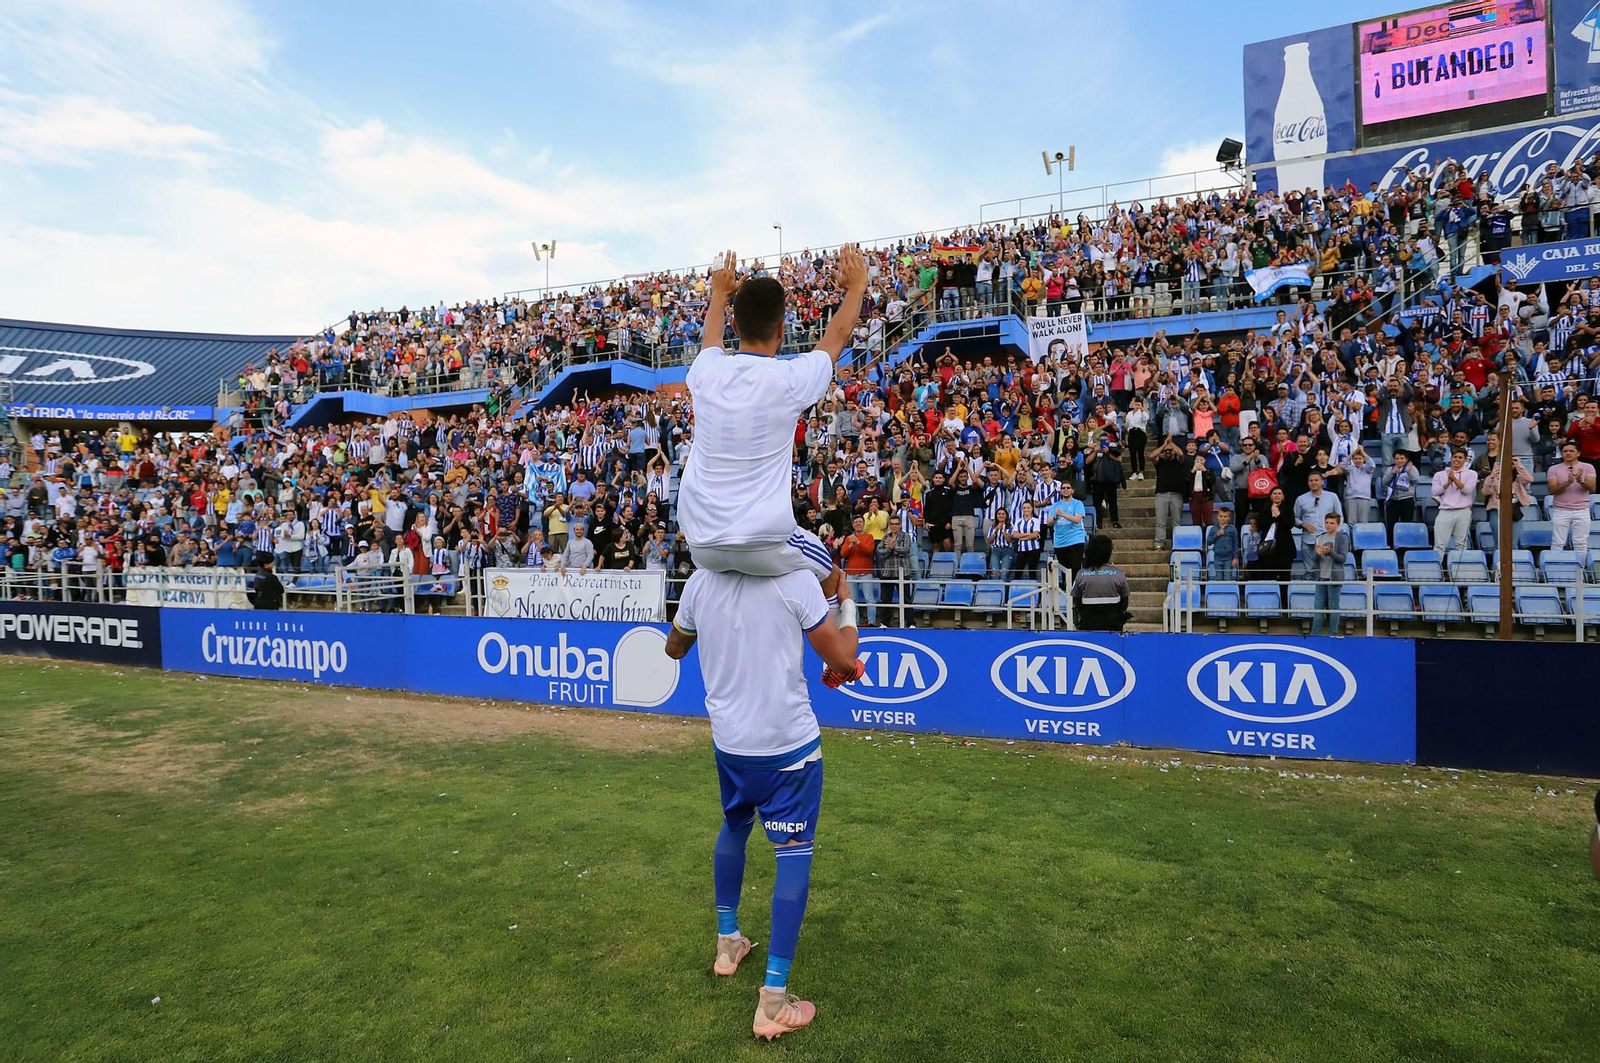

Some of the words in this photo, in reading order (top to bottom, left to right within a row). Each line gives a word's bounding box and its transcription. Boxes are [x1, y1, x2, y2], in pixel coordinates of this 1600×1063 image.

[1392, 41, 1514, 90] BUFANDEO
[1560, 89, 1589, 99] Refresco
[1275, 115, 1325, 144] Coca-Cola
[1542, 247, 1580, 260] CAJA
[1565, 263, 1589, 273] DEL
[1058, 314, 1083, 325] NEVER
[1032, 328, 1055, 339] WALK
[1057, 323, 1082, 335] ALONE
[137, 411, 153, 420] del
[530, 574, 558, 587] Peña
[563, 574, 642, 590] Recreativista
[514, 590, 566, 618] Nuevo
[570, 593, 652, 621] Colombino
[0, 613, 139, 648] POWERADE
[235, 621, 267, 631] DESDE
[202, 623, 347, 678] Cruzcampo
[477, 632, 610, 682] Onuba
[1014, 655, 1111, 697] KIA
[1215, 661, 1328, 706] KIA
[549, 682, 608, 704] FRUIT
[851, 709, 916, 725] VEYSER
[1025, 719, 1101, 737] VEYSER
[1227, 730, 1316, 750] VEYSER
